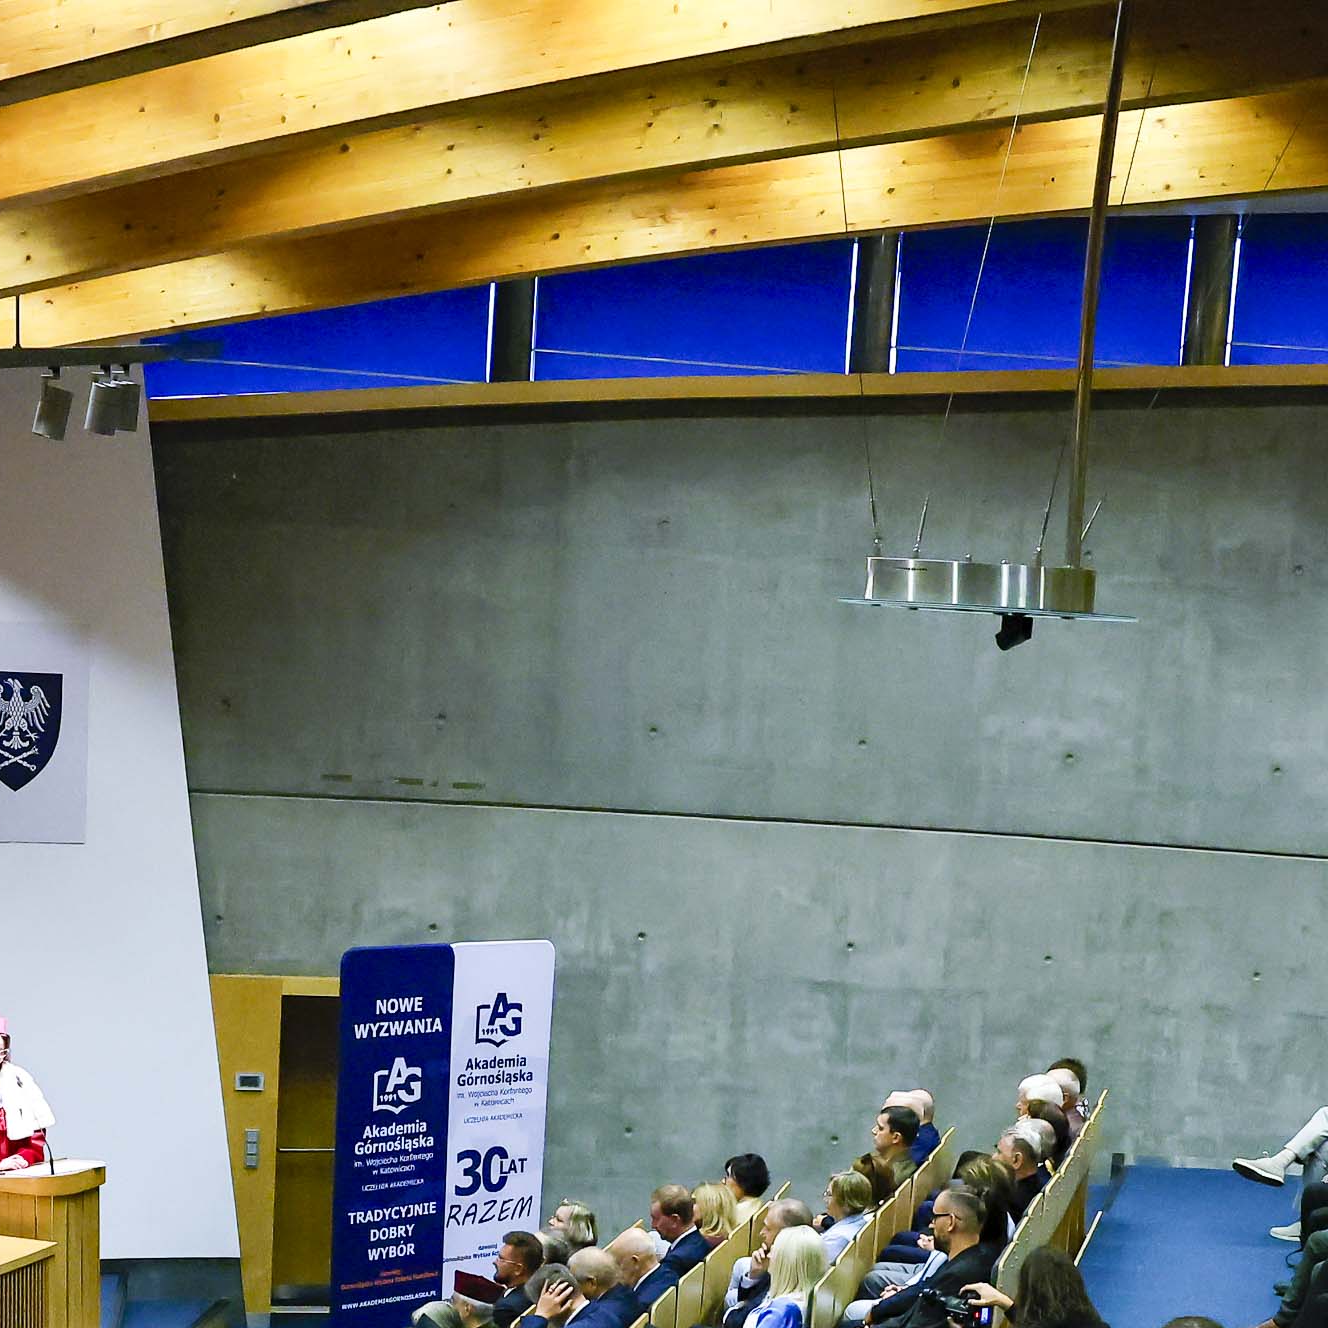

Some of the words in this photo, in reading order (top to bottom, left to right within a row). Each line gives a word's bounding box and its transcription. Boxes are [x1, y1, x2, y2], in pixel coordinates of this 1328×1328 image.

[375, 996, 423, 1015] NOWE
[488, 992, 523, 1037] AG
[353, 1017, 443, 1040] WYZWANIA
[465, 1054, 528, 1071] Akademia
[385, 1056, 422, 1103] AG
[456, 1069, 534, 1087] Górnośląska
[379, 1092, 397, 1103] 1991
[362, 1119, 427, 1139] Akademia
[354, 1134, 434, 1155] Górnośląska
[455, 1146, 509, 1196] 30
[499, 1158, 528, 1175] LAT
[347, 1201, 437, 1225] TRADYCYJNIE
[446, 1195, 533, 1228] RAZEM
[369, 1223, 415, 1242] DOBRY
[367, 1240, 416, 1261] WYBÓR
